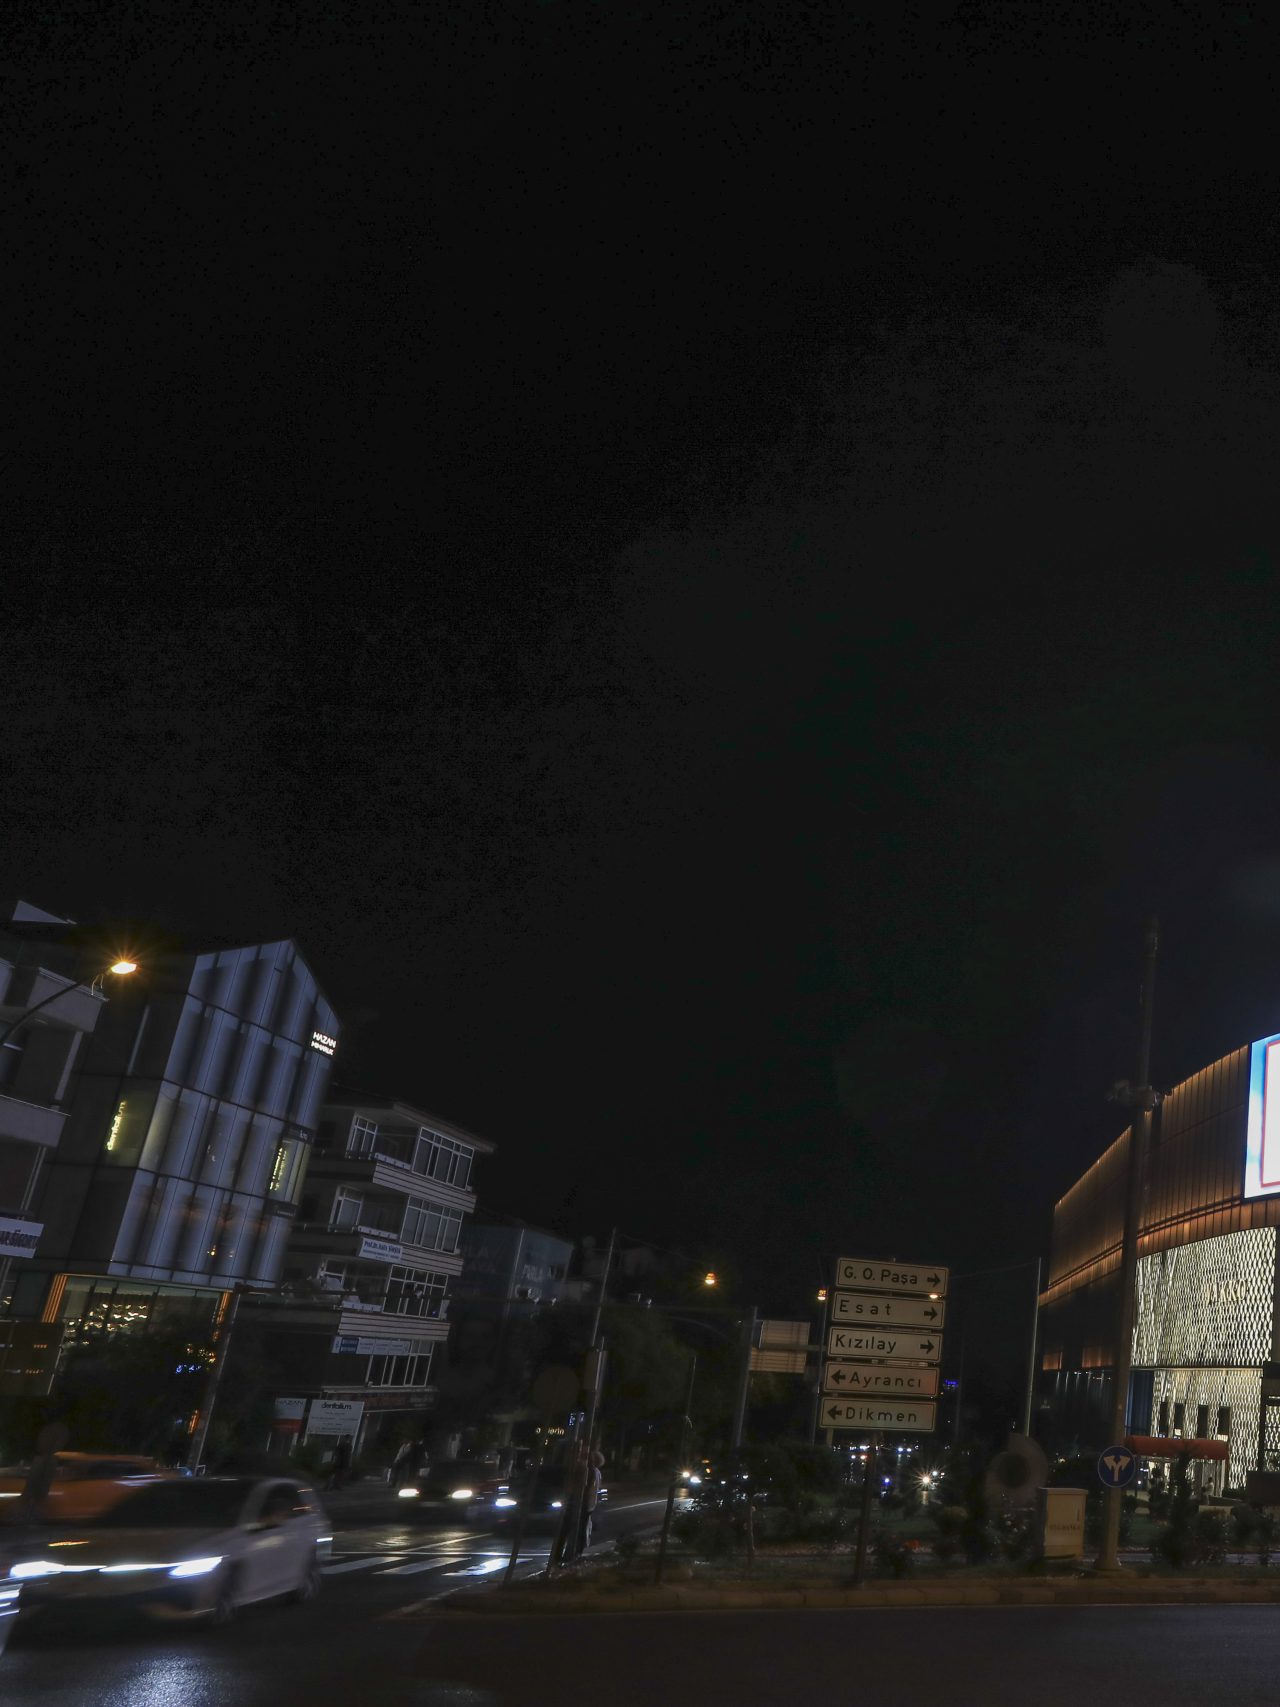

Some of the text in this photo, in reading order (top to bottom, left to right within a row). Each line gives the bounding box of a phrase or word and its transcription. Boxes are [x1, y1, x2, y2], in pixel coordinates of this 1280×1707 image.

[313, 1031, 337, 1048] HAZAN
[843, 1265, 918, 1285] G. O. Paşa
[839, 1300, 892, 1316] Esat
[835, 1334, 897, 1354] Kızılay
[849, 1371, 921, 1388] Ayrancı
[845, 1407, 917, 1423] Dikmen
